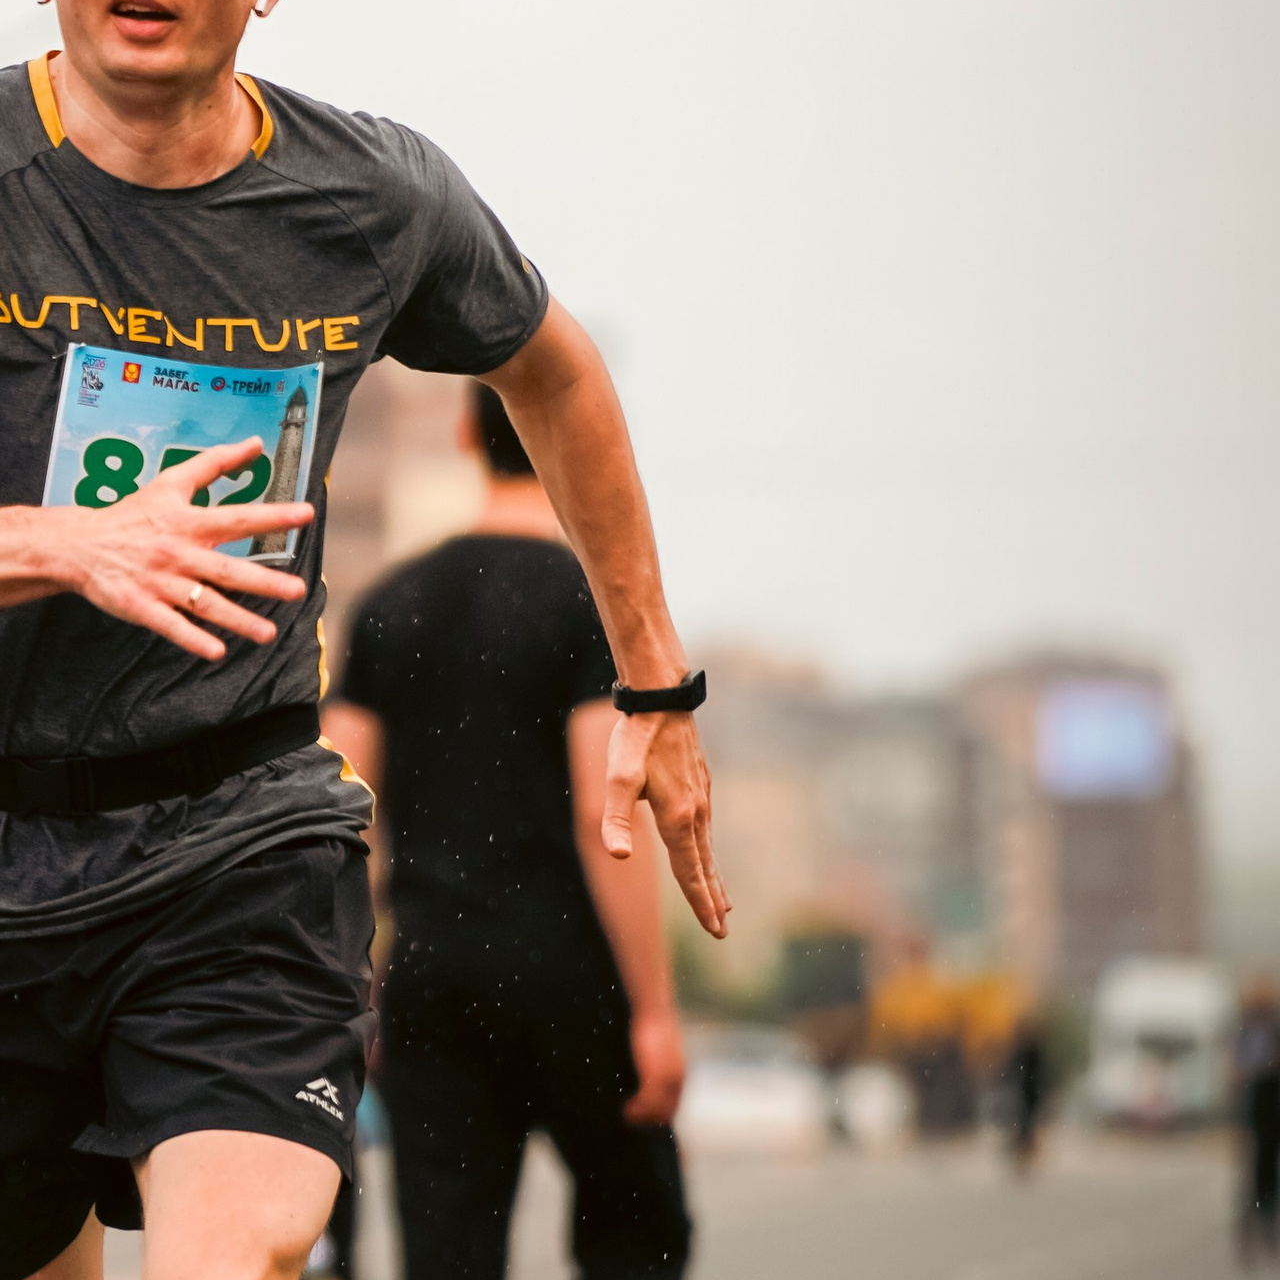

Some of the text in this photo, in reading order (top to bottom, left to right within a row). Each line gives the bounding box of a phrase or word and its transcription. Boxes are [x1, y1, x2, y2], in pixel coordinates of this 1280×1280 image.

[154, 366, 188, 380] ЗАБЕГ
[153, 376, 200, 392] МАГАС
[295, 1090, 344, 1121] ATHLEX
